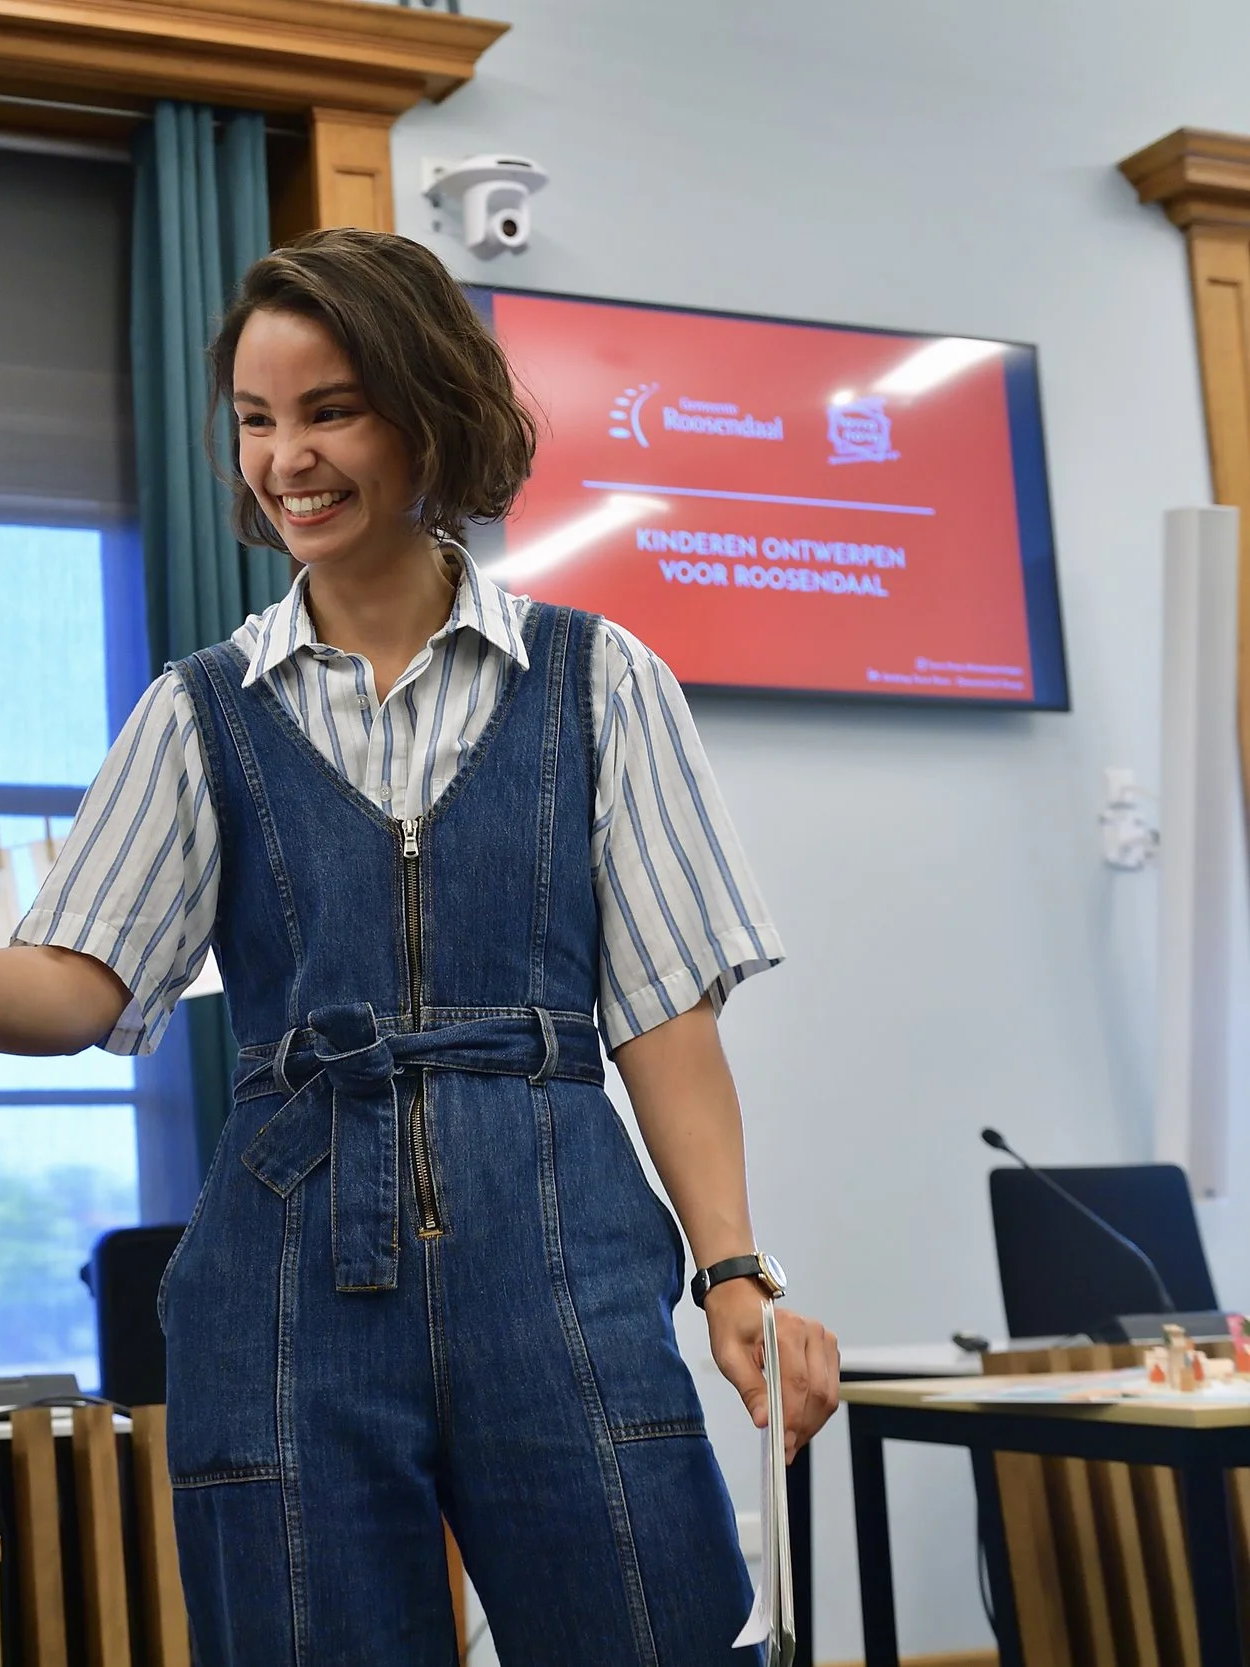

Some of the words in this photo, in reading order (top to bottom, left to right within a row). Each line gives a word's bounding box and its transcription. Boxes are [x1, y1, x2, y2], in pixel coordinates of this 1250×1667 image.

[661, 406, 784, 441] Roosendaal
[636, 527, 757, 559] KINDEREN
[762, 536, 907, 569] ONTWERPEN
[658, 559, 729, 586] VOOR
[734, 564, 889, 598] ROOSENDAAL
